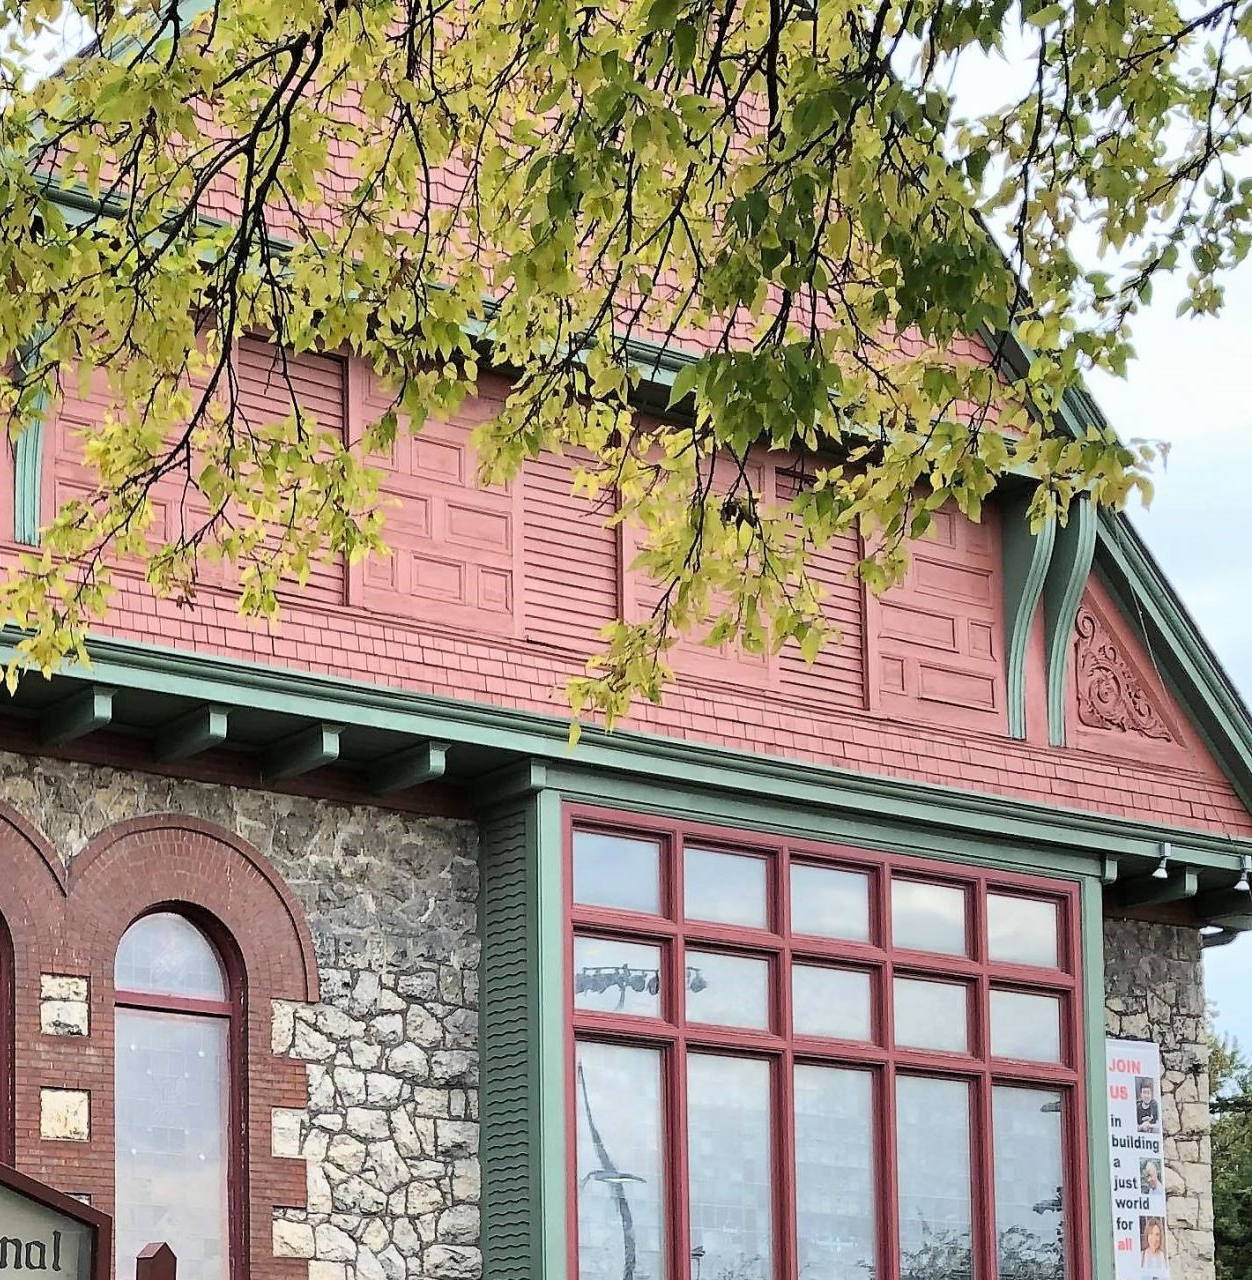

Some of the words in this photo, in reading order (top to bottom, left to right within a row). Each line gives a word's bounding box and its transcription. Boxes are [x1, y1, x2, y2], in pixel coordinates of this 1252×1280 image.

[1109, 1059, 1141, 1073] JOIN
[1110, 1086, 1128, 1099] US
[1110, 1114, 1122, 1128] in
[1111, 1134, 1160, 1153] building
[1113, 1158, 1121, 1168] a
[1114, 1175, 1138, 1191] just
[1115, 1197, 1150, 1210] world
[1116, 1217, 1134, 1231] for
[1117, 1238, 1132, 1251] all
